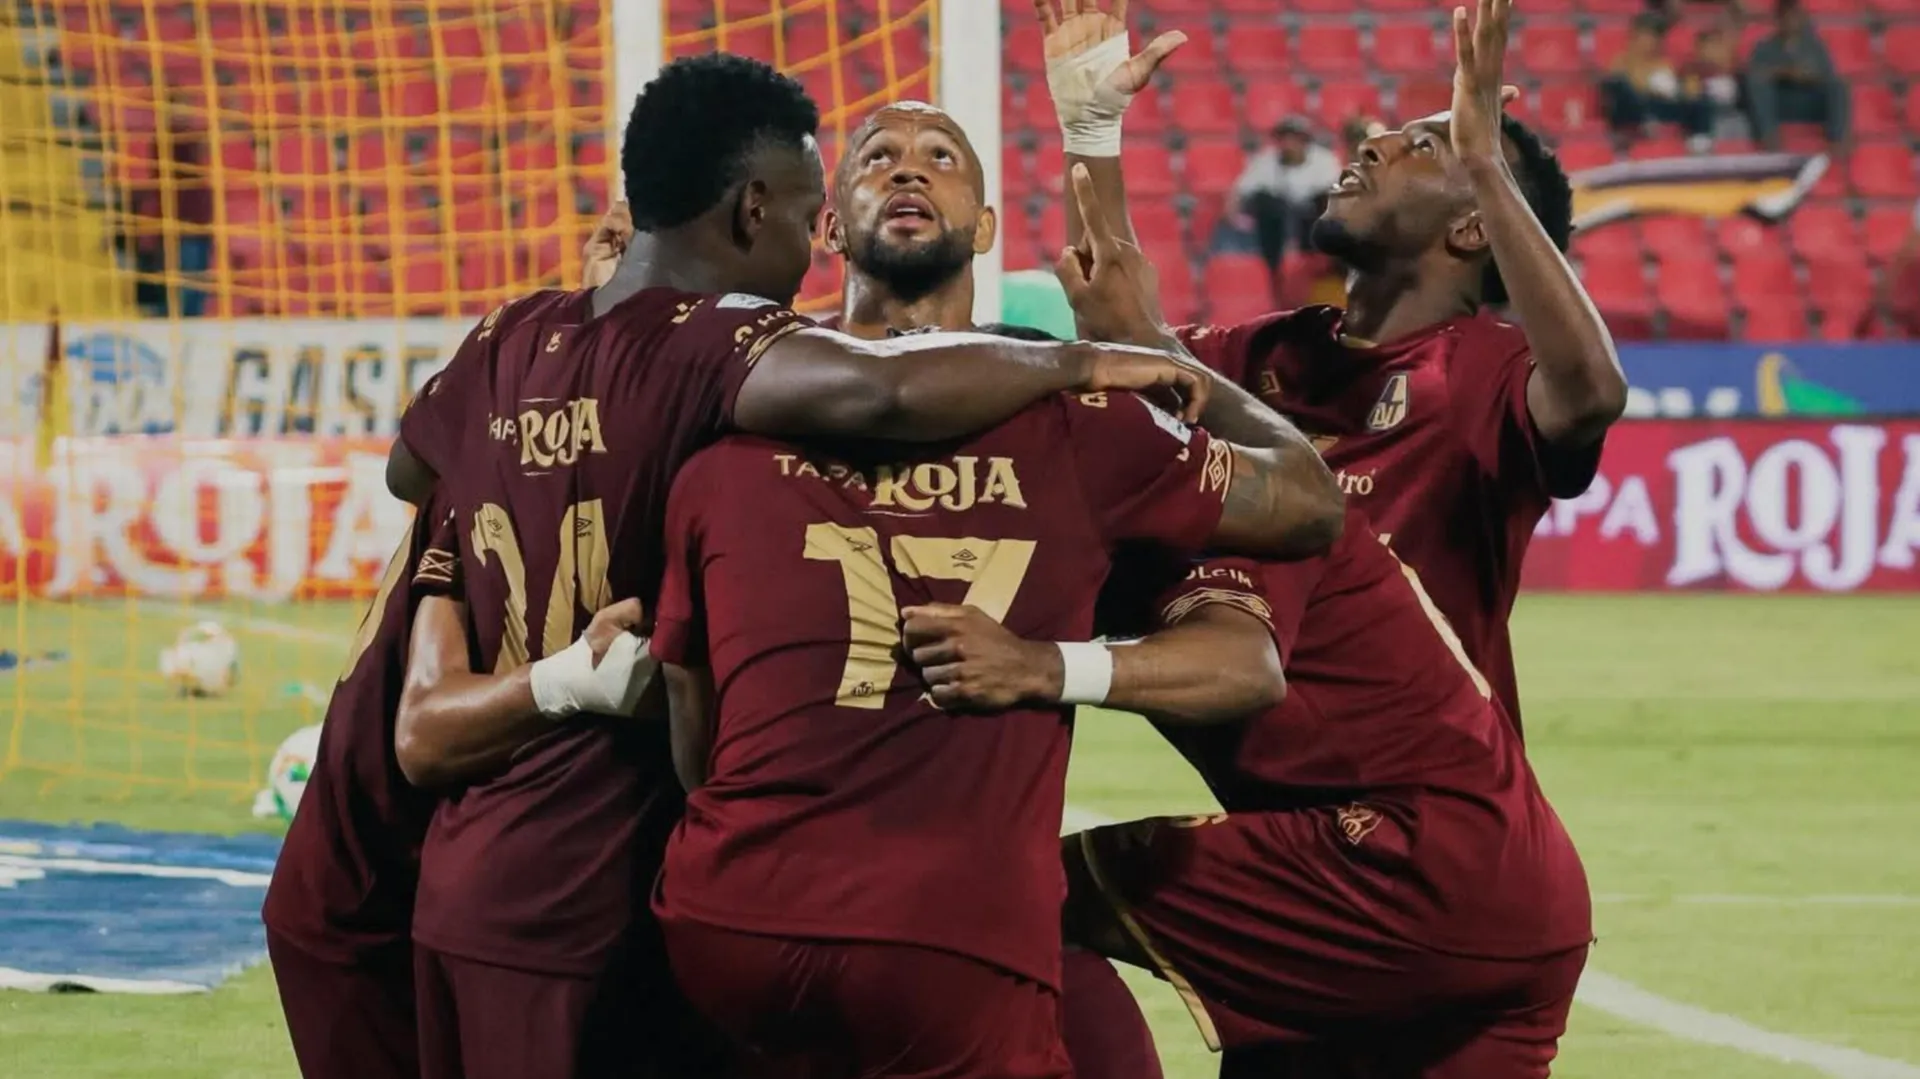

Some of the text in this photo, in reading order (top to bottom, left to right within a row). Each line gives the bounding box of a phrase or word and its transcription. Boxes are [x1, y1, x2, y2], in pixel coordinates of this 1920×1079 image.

[518, 397, 607, 468] ROJA
[869, 455, 1028, 512] ROJA
[47, 437, 416, 602] ROJA
[471, 498, 613, 675] 14
[803, 522, 1038, 710] 17
